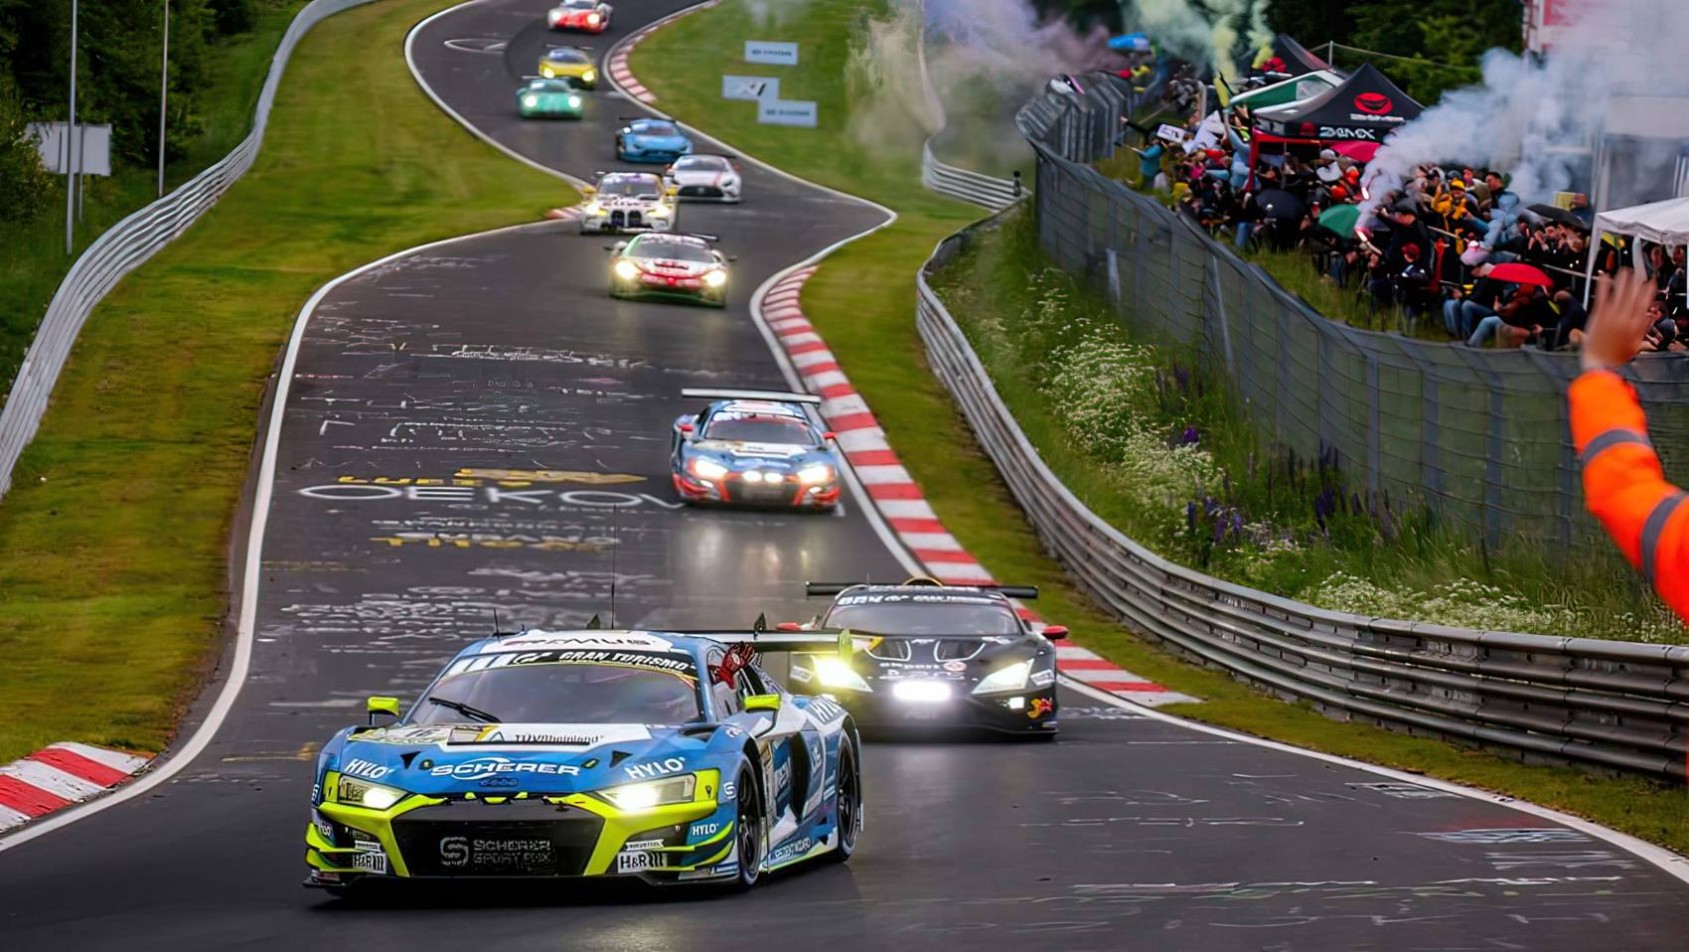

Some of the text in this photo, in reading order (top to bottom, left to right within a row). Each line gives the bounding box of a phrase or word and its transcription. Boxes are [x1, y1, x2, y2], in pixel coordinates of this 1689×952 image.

[558, 650, 612, 661] GRAN
[612, 651, 691, 671] TURISMO
[344, 758, 388, 779] HYLO
[431, 760, 581, 777] SCHERER
[624, 757, 685, 780] HYLO
[692, 823, 719, 836] HYLO
[473, 839, 551, 851] SCHERER
[620, 853, 647, 869] H&R
